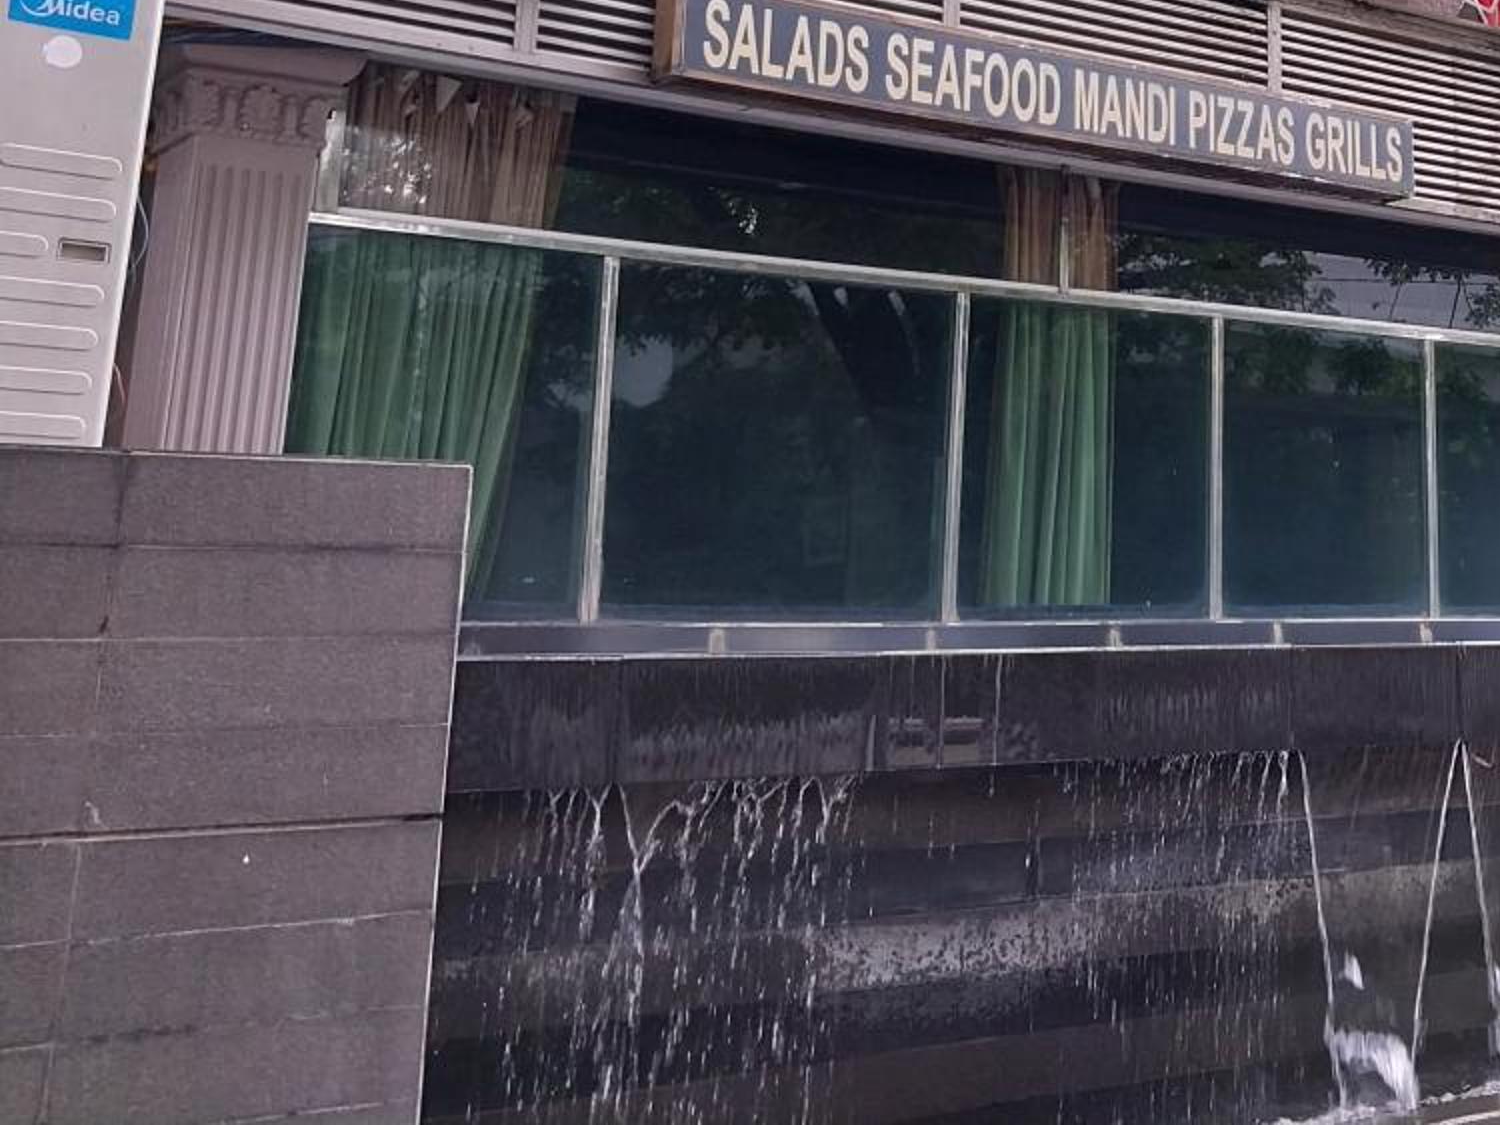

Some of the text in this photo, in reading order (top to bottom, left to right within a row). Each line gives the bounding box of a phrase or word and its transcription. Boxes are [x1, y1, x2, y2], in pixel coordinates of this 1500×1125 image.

[885, 32, 1060, 126] SEAFOOD
[1074, 78, 1175, 142] MANDI
[1190, 105, 1295, 164] PIZZAS
[1305, 115, 1403, 182] GRILLS
